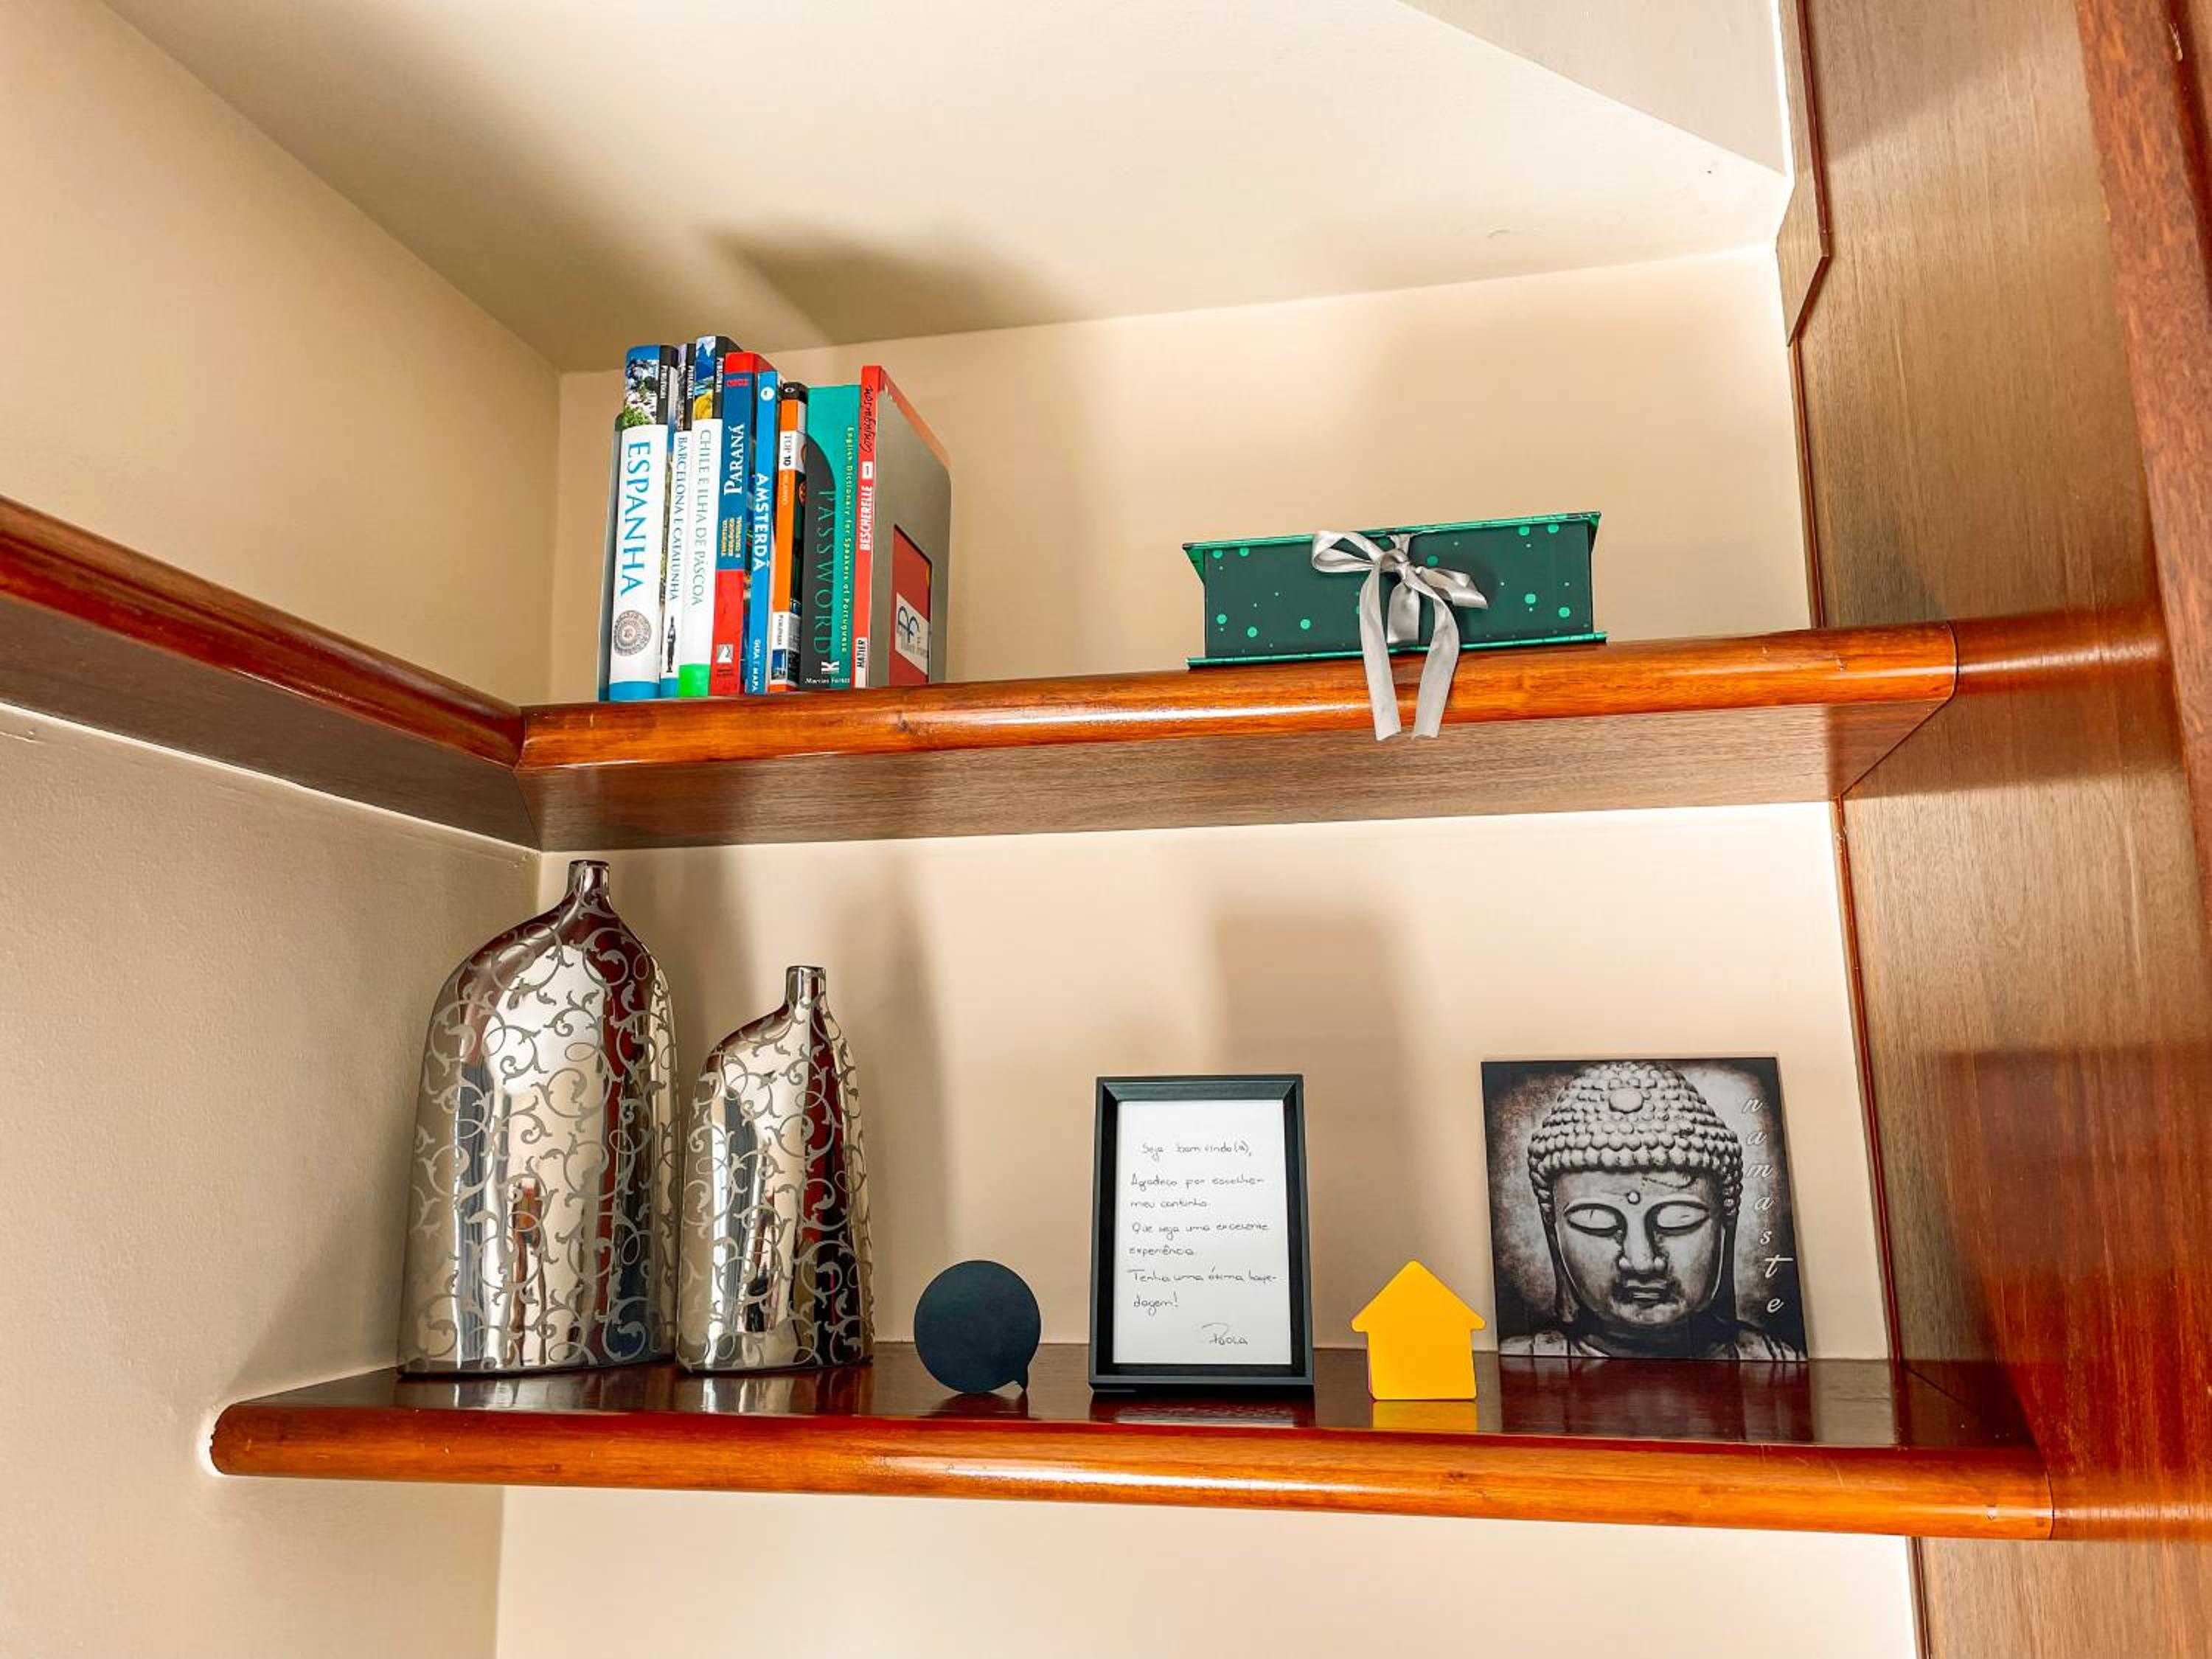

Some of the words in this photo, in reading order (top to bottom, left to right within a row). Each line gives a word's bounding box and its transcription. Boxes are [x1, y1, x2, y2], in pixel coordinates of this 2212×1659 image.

[699, 429, 712, 473] CHILE
[784, 456, 790, 466] 10
[675, 436, 688, 514] BARCELONA
[844, 466, 853, 515] Dictionary
[620, 441, 650, 598] ESPANHA
[696, 489, 709, 523] ILHA
[753, 473, 770, 571] AMSTERDÃ
[860, 486, 872, 551] BESCHERELLE
[695, 527, 707, 546] DE
[669, 527, 682, 602] CATALUNHA
[692, 552, 706, 606] PÁSCOA
[813, 490, 835, 654] PASSWORD
[844, 584, 849, 594] of
[841, 598, 849, 652] Portuguese
[857, 639, 866, 668] HATIER
[1186, 1178, 1206, 1189] por
[1741, 1096, 1794, 1315] namaste
[1132, 1222, 1153, 1234] Que
[1127, 1269, 1170, 1282] Tenha
[1201, 1322, 1249, 1346] Paola
